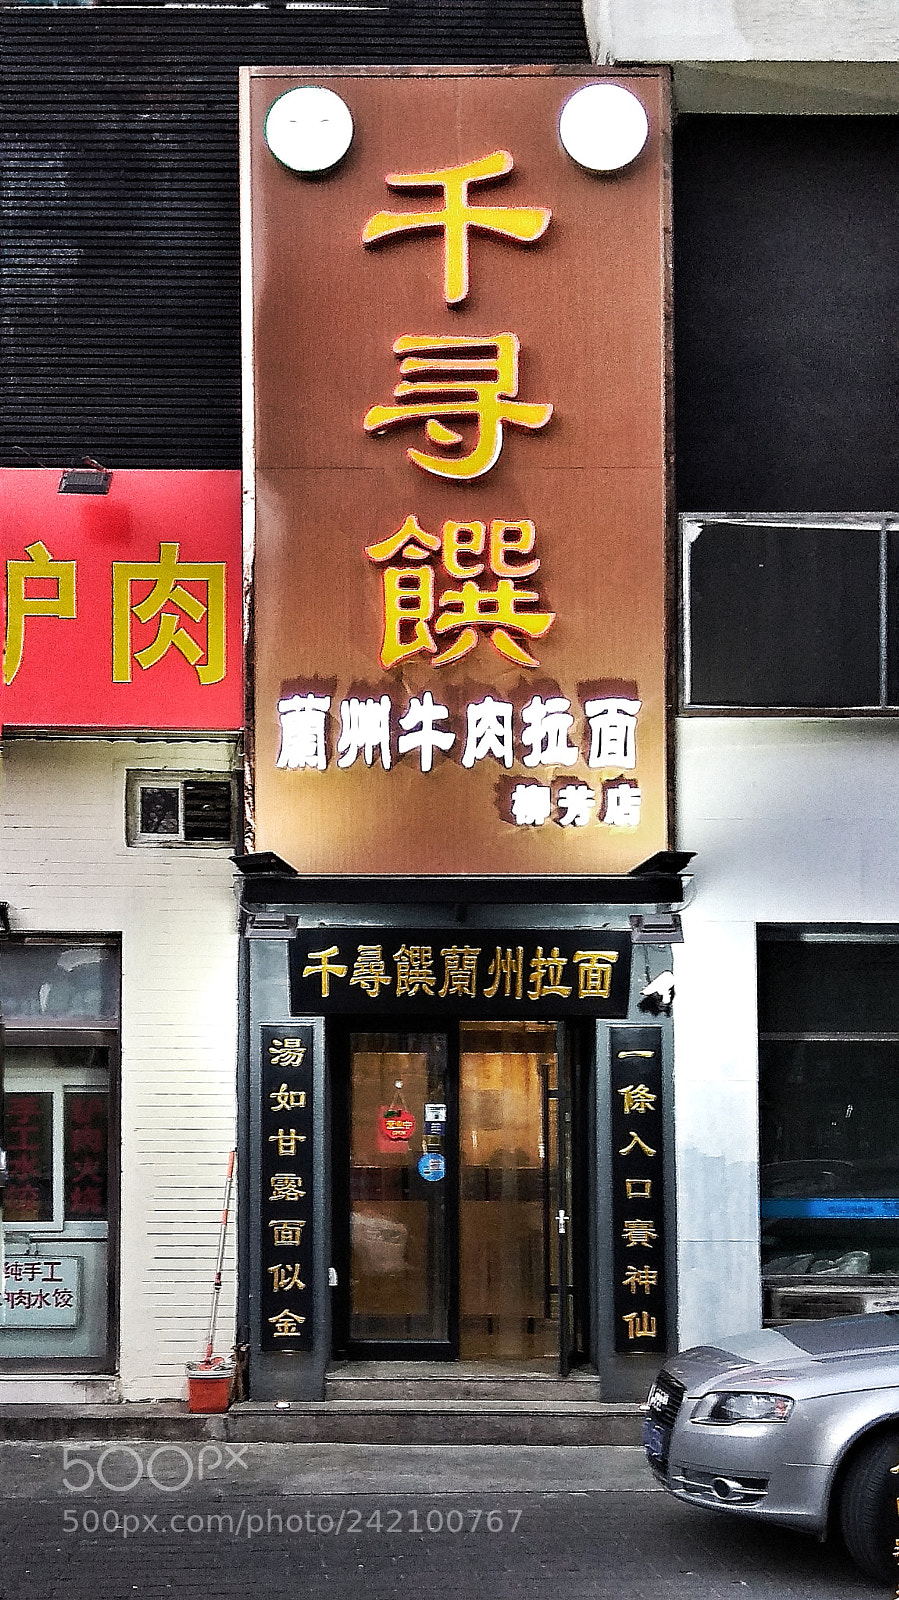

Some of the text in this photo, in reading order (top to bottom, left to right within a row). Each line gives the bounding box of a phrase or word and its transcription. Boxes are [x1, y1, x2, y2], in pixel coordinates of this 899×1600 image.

[4, 1261, 63, 1282] 纯手工
[267, 1038, 307, 1337] 湯如甘露面似金
[617, 1050, 659, 1339] 一條入口賽神仙
